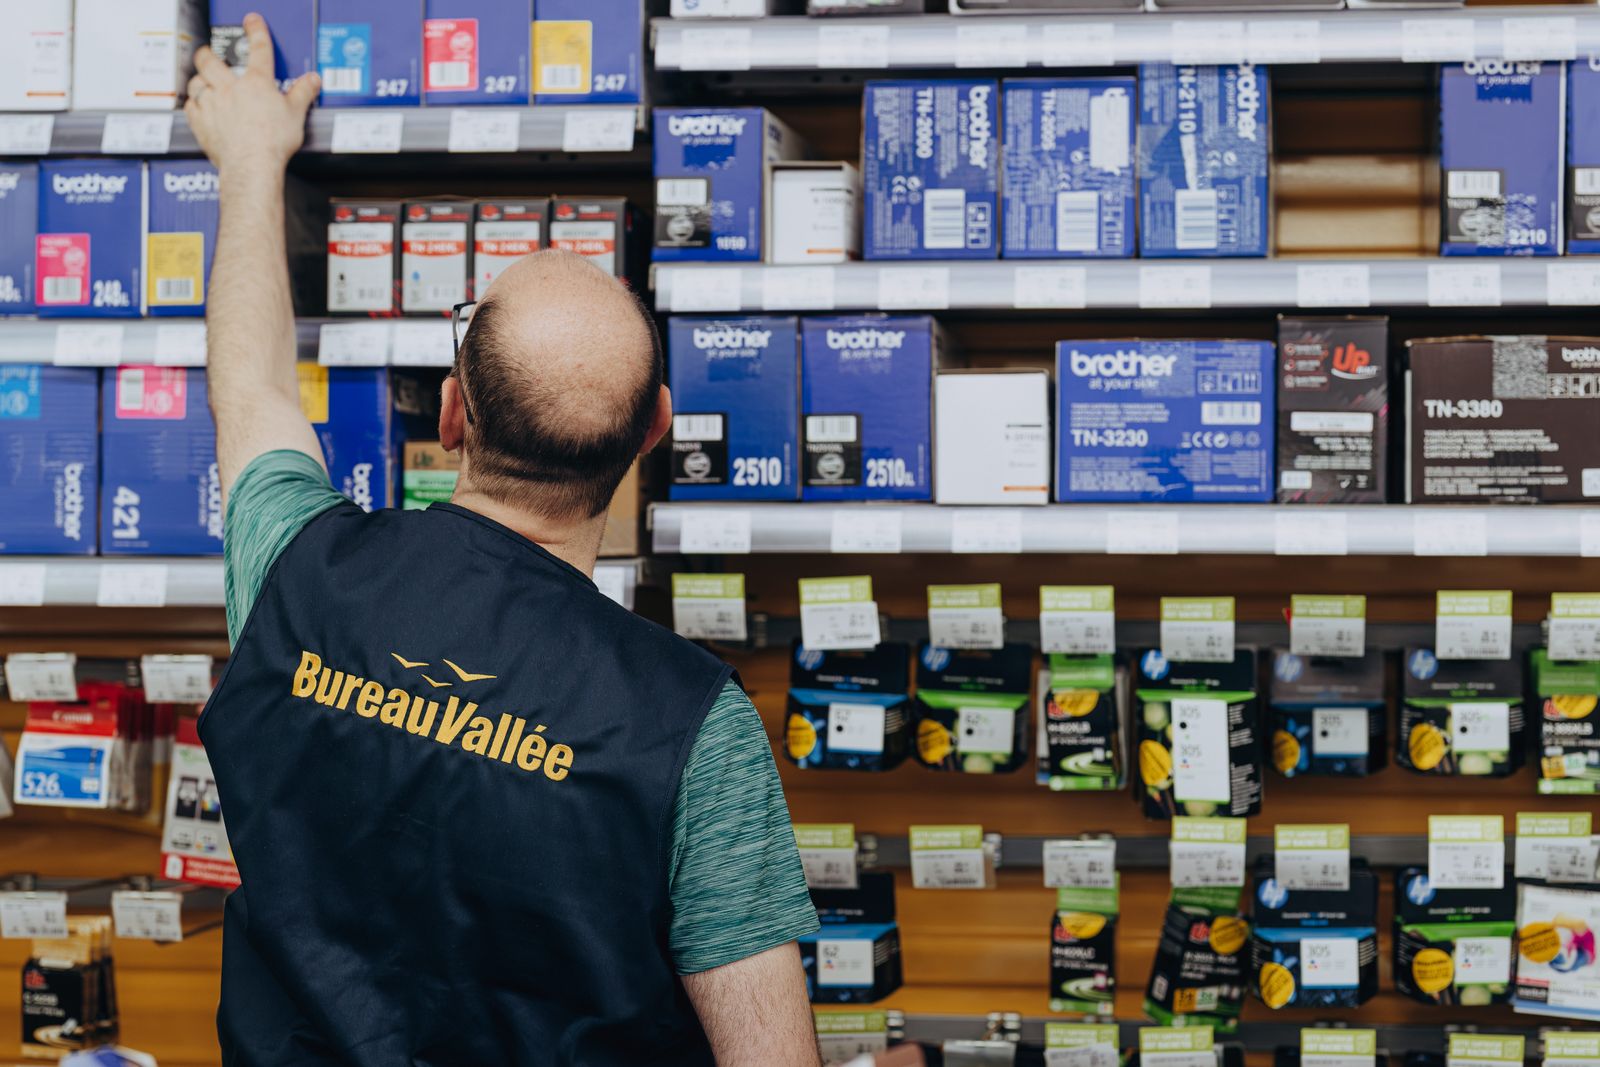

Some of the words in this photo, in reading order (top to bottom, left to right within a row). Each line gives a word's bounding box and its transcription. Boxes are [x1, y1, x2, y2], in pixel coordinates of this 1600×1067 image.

[376, 78, 408, 97] 247
[485, 75, 517, 94] 247
[594, 74, 627, 92] 247
[1178, 67, 1197, 133] N-2110
[668, 114, 747, 136] brother
[969, 85, 991, 169] brother
[53, 173, 129, 195] brother
[164, 172, 219, 193] broth
[1508, 229, 1548, 246] 2210
[693, 328, 772, 350] brother
[826, 329, 906, 350] brother
[1070, 350, 1178, 378] brother
[1561, 347, 1600, 362] broth
[1088, 378, 1102, 391] at
[1103, 380, 1132, 392] your
[1134, 378, 1160, 390] side
[1423, 400, 1503, 418] TN-3380
[1070, 429, 1149, 447] TN-3230
[733, 457, 782, 486] 2510
[352, 463, 374, 513] brot
[64, 463, 85, 541] brother
[112, 486, 141, 539] 421
[52, 710, 94, 724] Canon
[23, 771, 60, 797] 526
